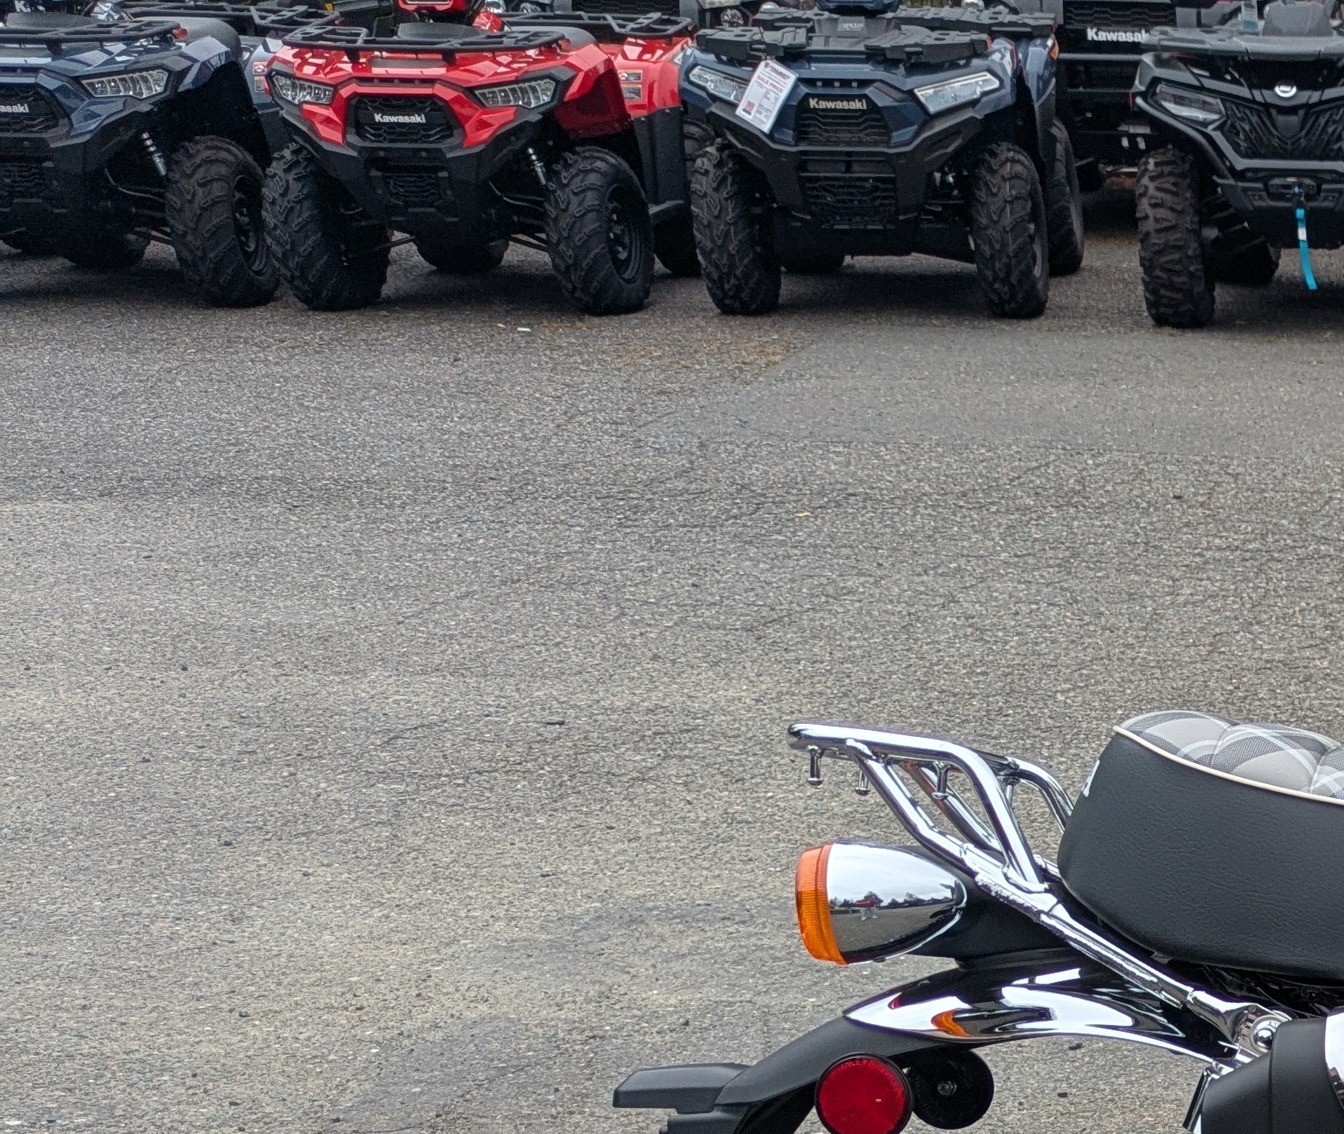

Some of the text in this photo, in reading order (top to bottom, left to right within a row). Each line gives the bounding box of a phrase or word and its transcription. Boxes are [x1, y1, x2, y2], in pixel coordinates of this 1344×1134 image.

[1086, 26, 1150, 42] Kawasak
[0, 103, 30, 113] asaki
[808, 98, 868, 110] Kawasaki
[373, 112, 427, 124] Kawasaki
